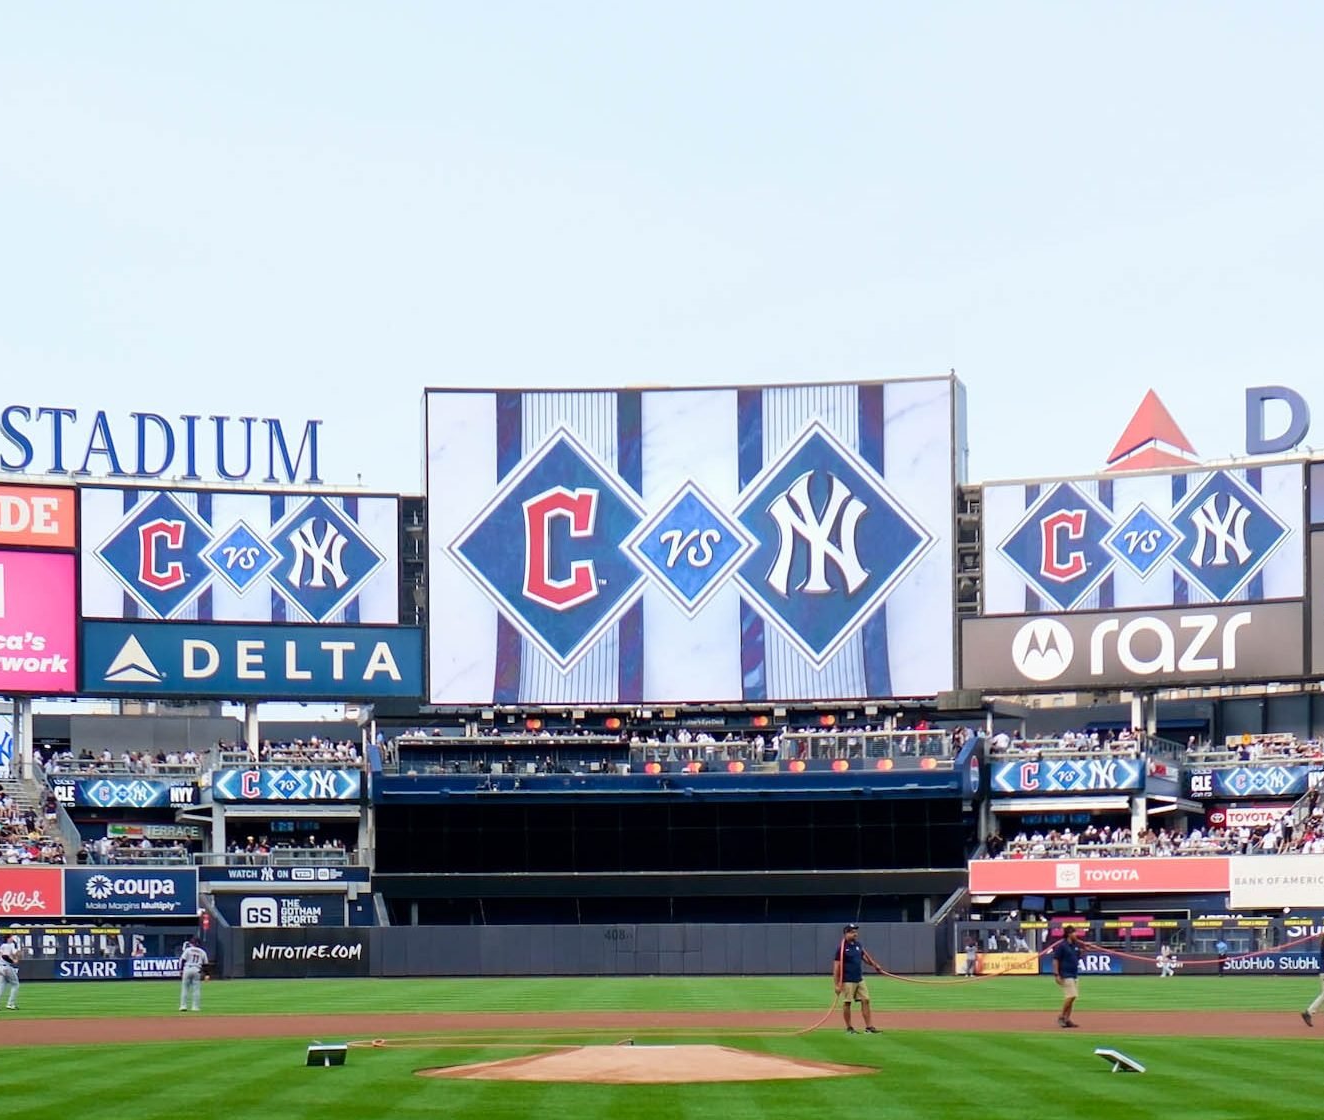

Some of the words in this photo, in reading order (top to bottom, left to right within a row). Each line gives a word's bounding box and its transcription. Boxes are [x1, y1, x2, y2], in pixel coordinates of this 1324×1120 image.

[0, 404, 325, 485] STADIUM
[522, 485, 600, 612] C
[1039, 508, 1087, 583] C
[137, 517, 186, 592] C
[1090, 611, 1252, 676] razr
[182, 639, 403, 681] DELTA
[1191, 775, 1213, 792] CLE
[54, 785, 75, 802] CLE
[170, 785, 194, 803] NYY
[1228, 811, 1274, 824] TOYOTA
[147, 825, 199, 837] TERRACE
[228, 869, 258, 878] WATCH
[277, 869, 289, 878] ON
[1085, 868, 1139, 881] TOYOTA
[1234, 877, 1264, 886] BANK
[1266, 877, 1279, 885] OF
[113, 878, 175, 900] coupa
[85, 901, 106, 910] Make
[108, 901, 140, 912] Margins
[141, 900, 176, 912] Multiply
[280, 898, 300, 908] THE
[280, 907, 322, 916] GOTHAM
[247, 907, 272, 924] GS
[280, 915, 319, 924] SPORTS
[604, 928, 626, 941] 408
[252, 942, 363, 961] NITTOTIRE.COM
[59, 960, 118, 977] STARR
[1223, 957, 1275, 970] StubHub
